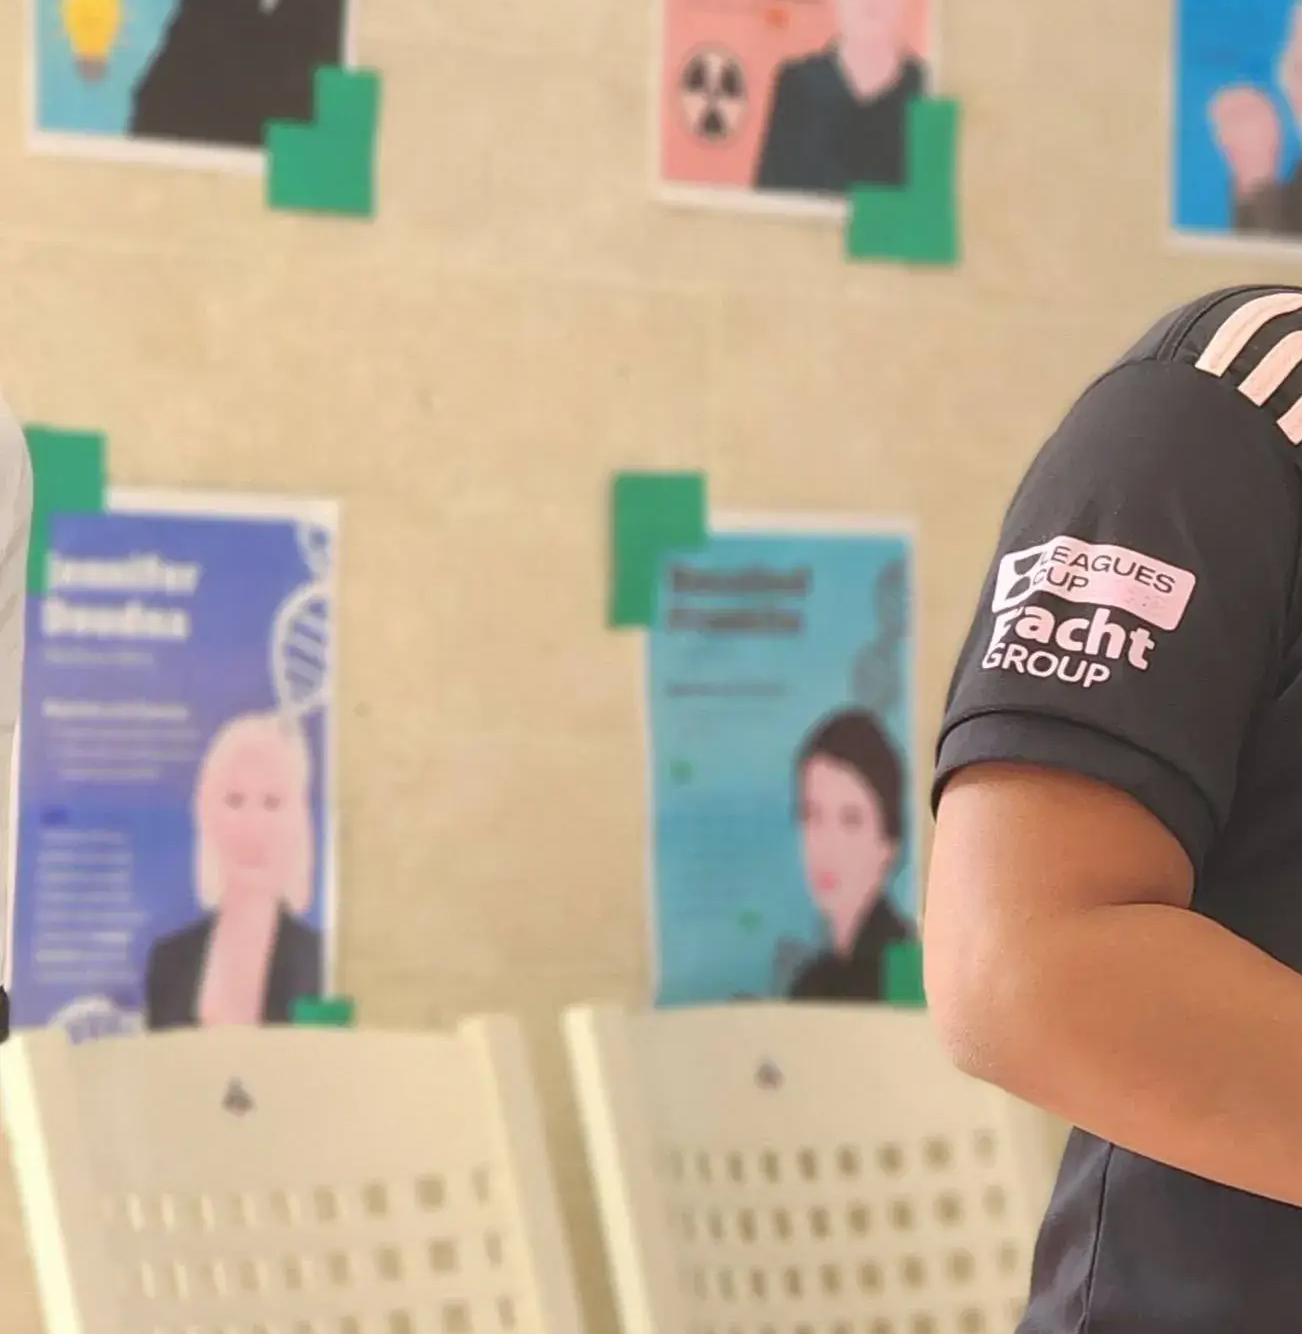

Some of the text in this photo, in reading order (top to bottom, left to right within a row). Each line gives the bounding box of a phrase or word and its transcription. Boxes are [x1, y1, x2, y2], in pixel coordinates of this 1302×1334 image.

[1033, 566, 1090, 592] CUP
[1040, 545, 1176, 594] LEAGUES
[981, 642, 1111, 688] GROUP
